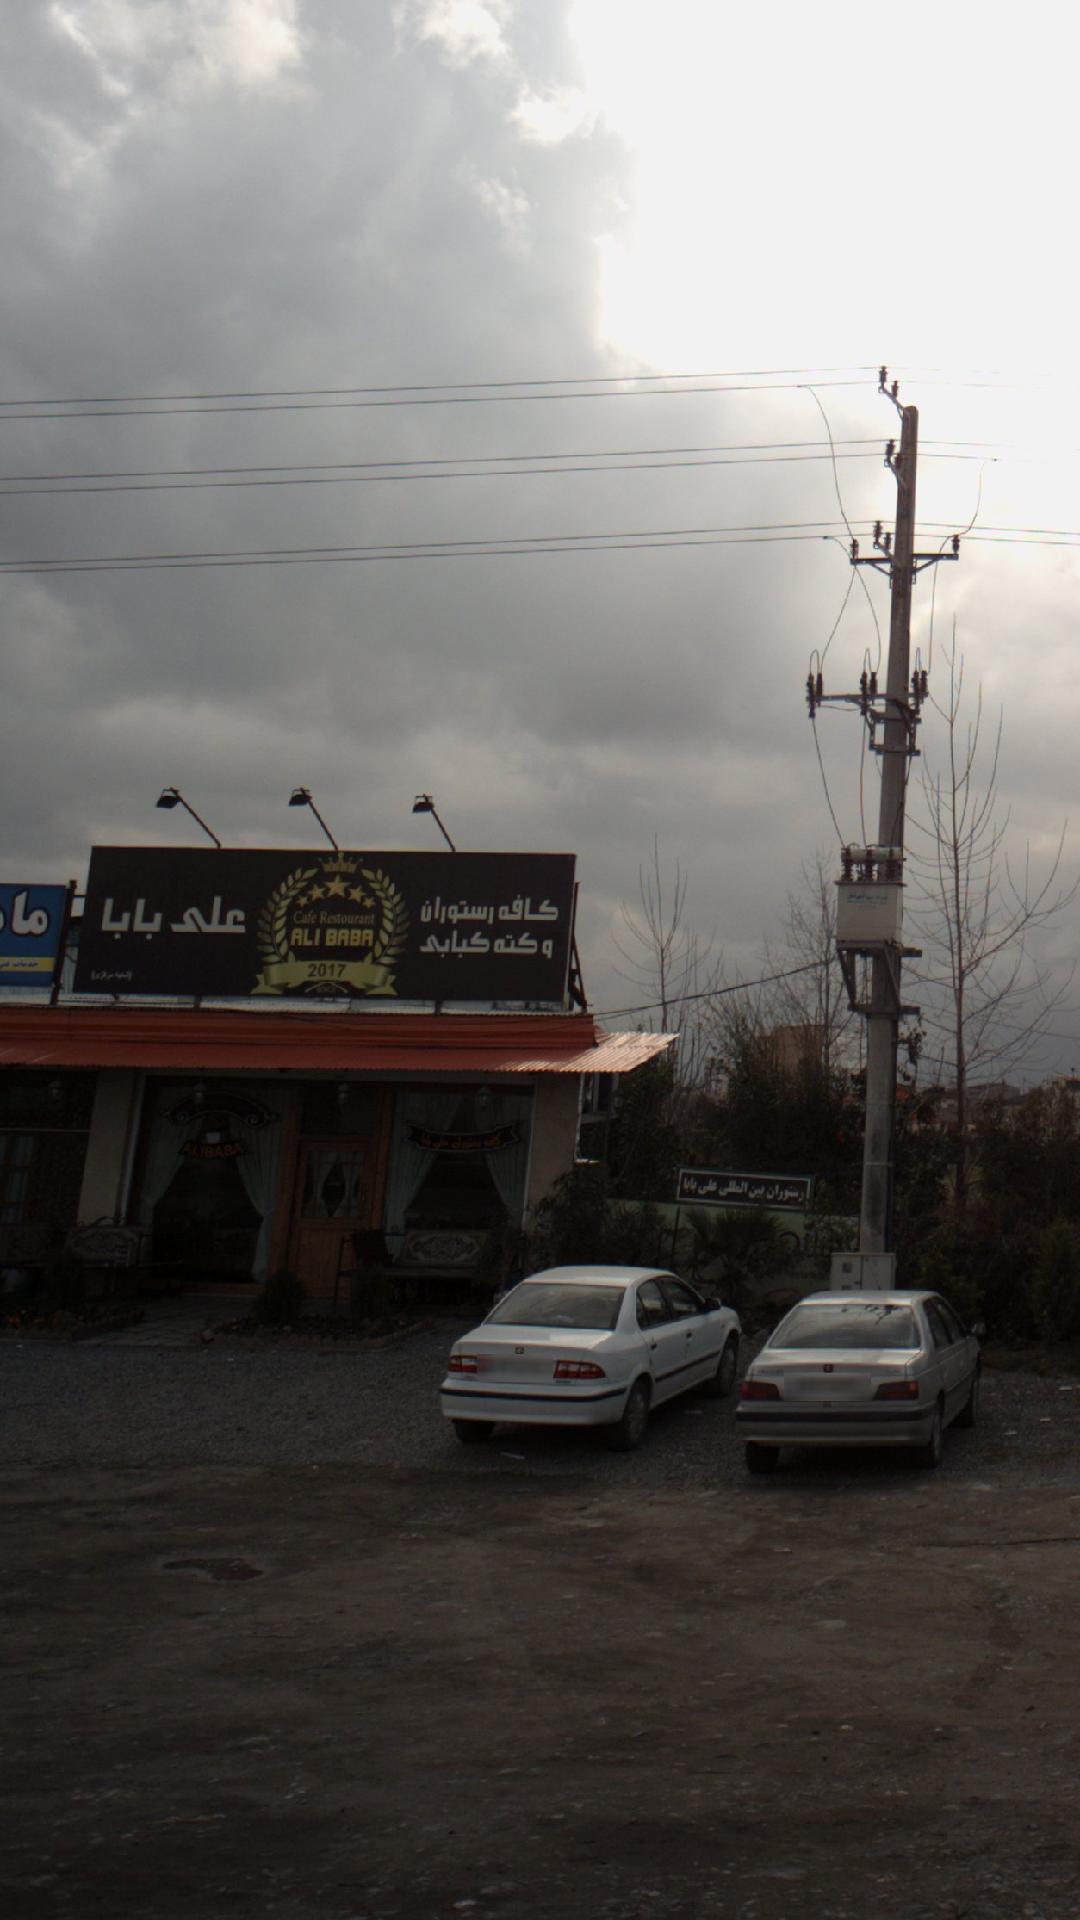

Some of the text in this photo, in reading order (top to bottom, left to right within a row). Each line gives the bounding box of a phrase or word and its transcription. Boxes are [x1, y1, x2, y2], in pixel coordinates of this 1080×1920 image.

[101, 896, 246, 940] علی بابا
[420, 894, 559, 925] کافه رستوران
[290, 928, 374, 946] ALI BABA
[420, 930, 553, 959] و کته کبابی
[307, 963, 347, 977] 2017
